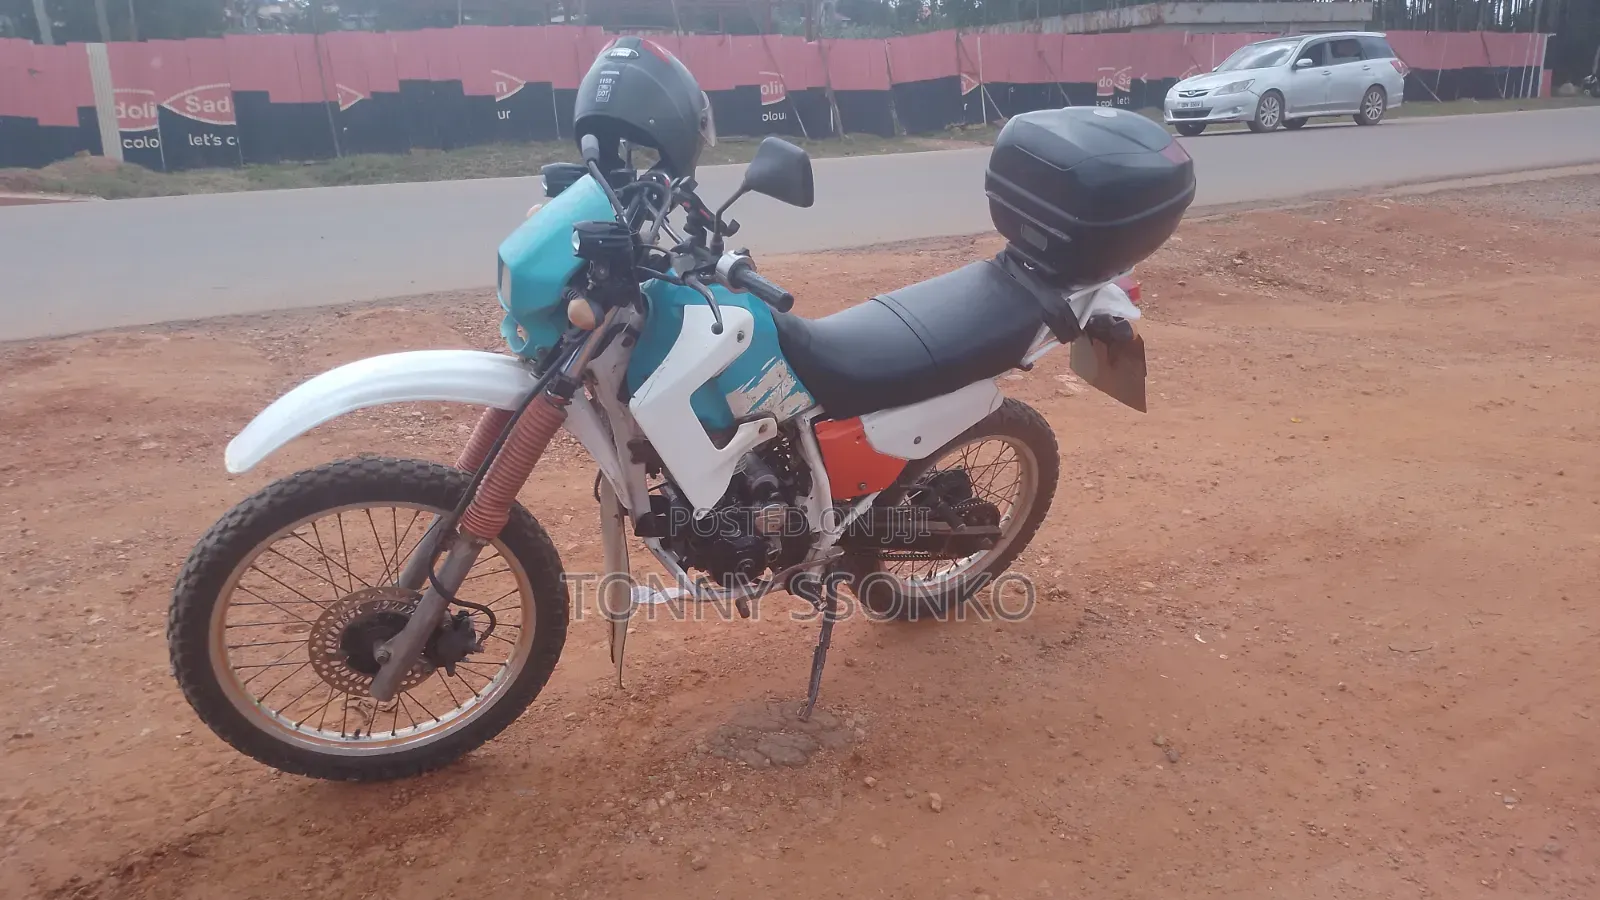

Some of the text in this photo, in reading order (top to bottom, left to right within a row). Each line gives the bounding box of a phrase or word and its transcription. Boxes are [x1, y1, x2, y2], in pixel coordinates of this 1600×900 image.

[186, 95, 231, 113] Sad
[123, 136, 160, 149] colo
[188, 134, 222, 146] let's
